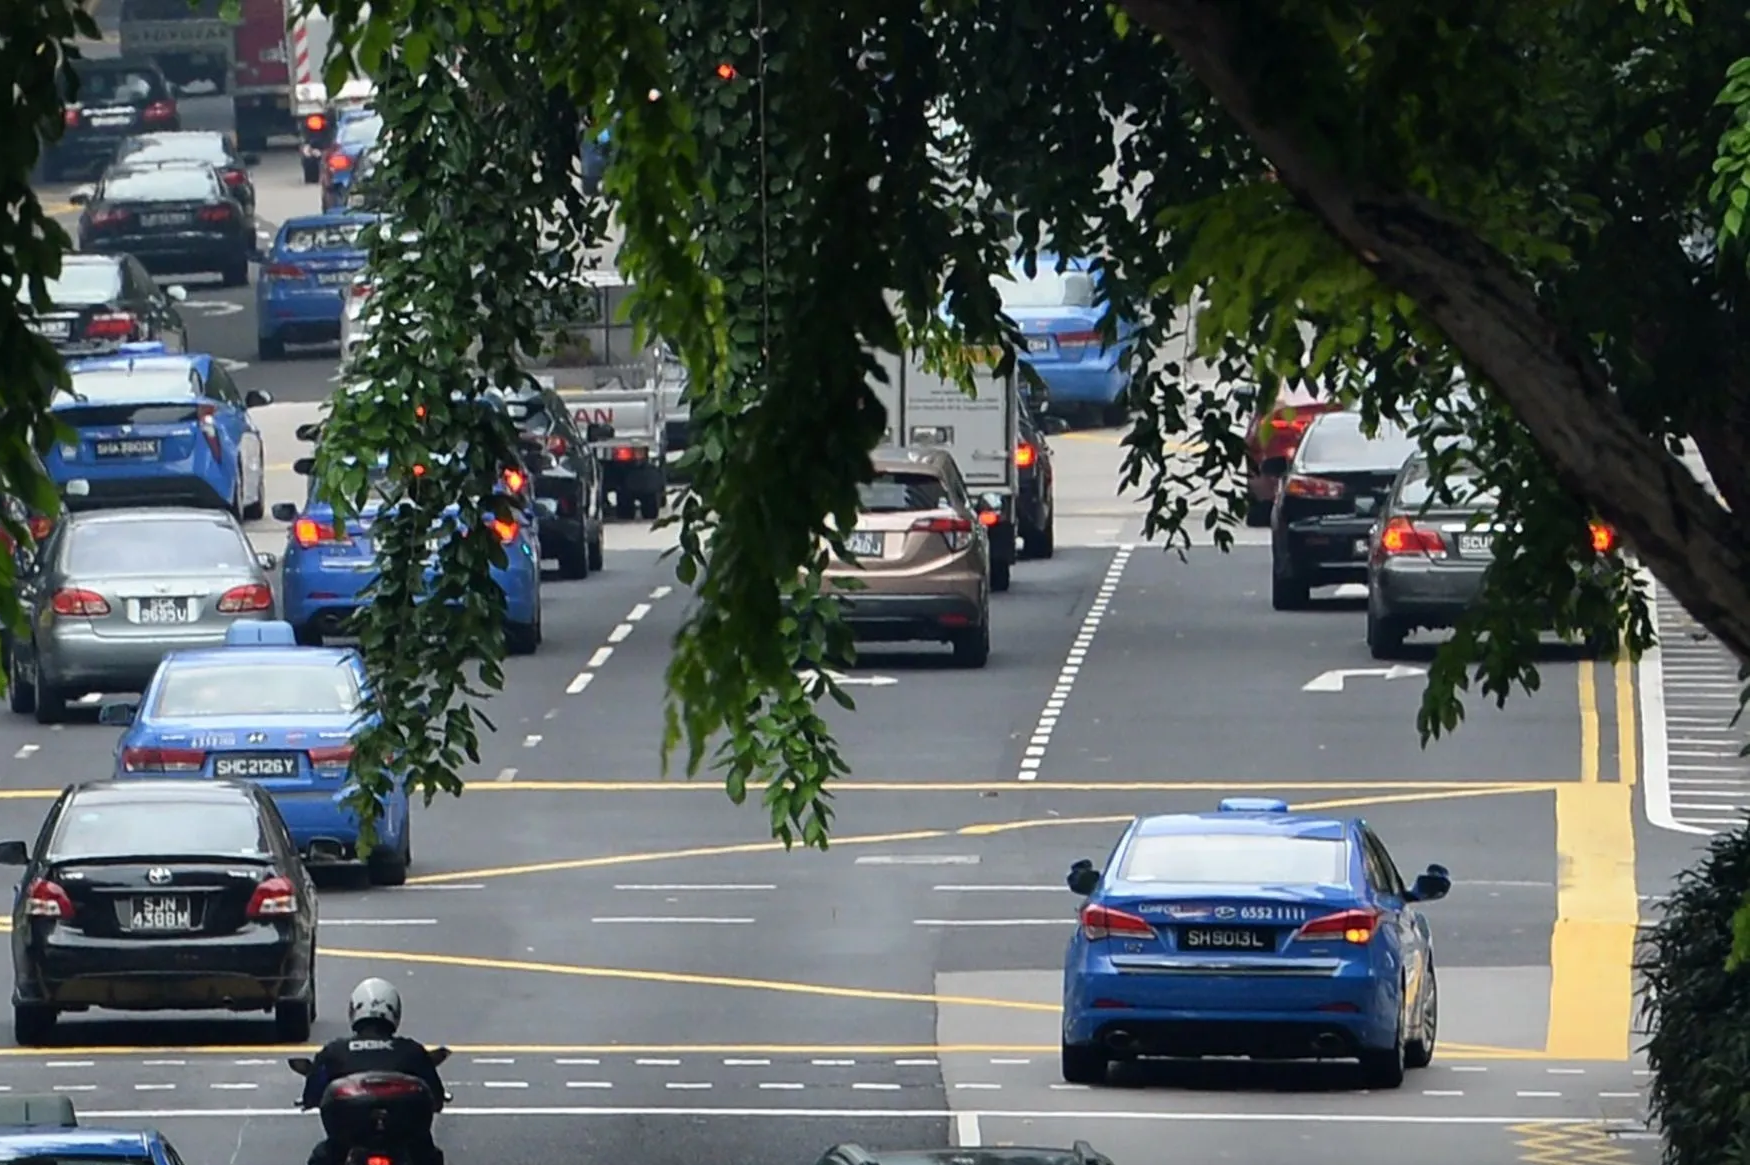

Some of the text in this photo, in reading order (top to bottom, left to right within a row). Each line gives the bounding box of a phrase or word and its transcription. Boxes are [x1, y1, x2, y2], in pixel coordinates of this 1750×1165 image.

[216, 759, 294, 776] SHC2126Y
[143, 898, 176, 913] SJN
[1240, 907, 1272, 920] 6552
[1277, 908, 1305, 921] 1111
